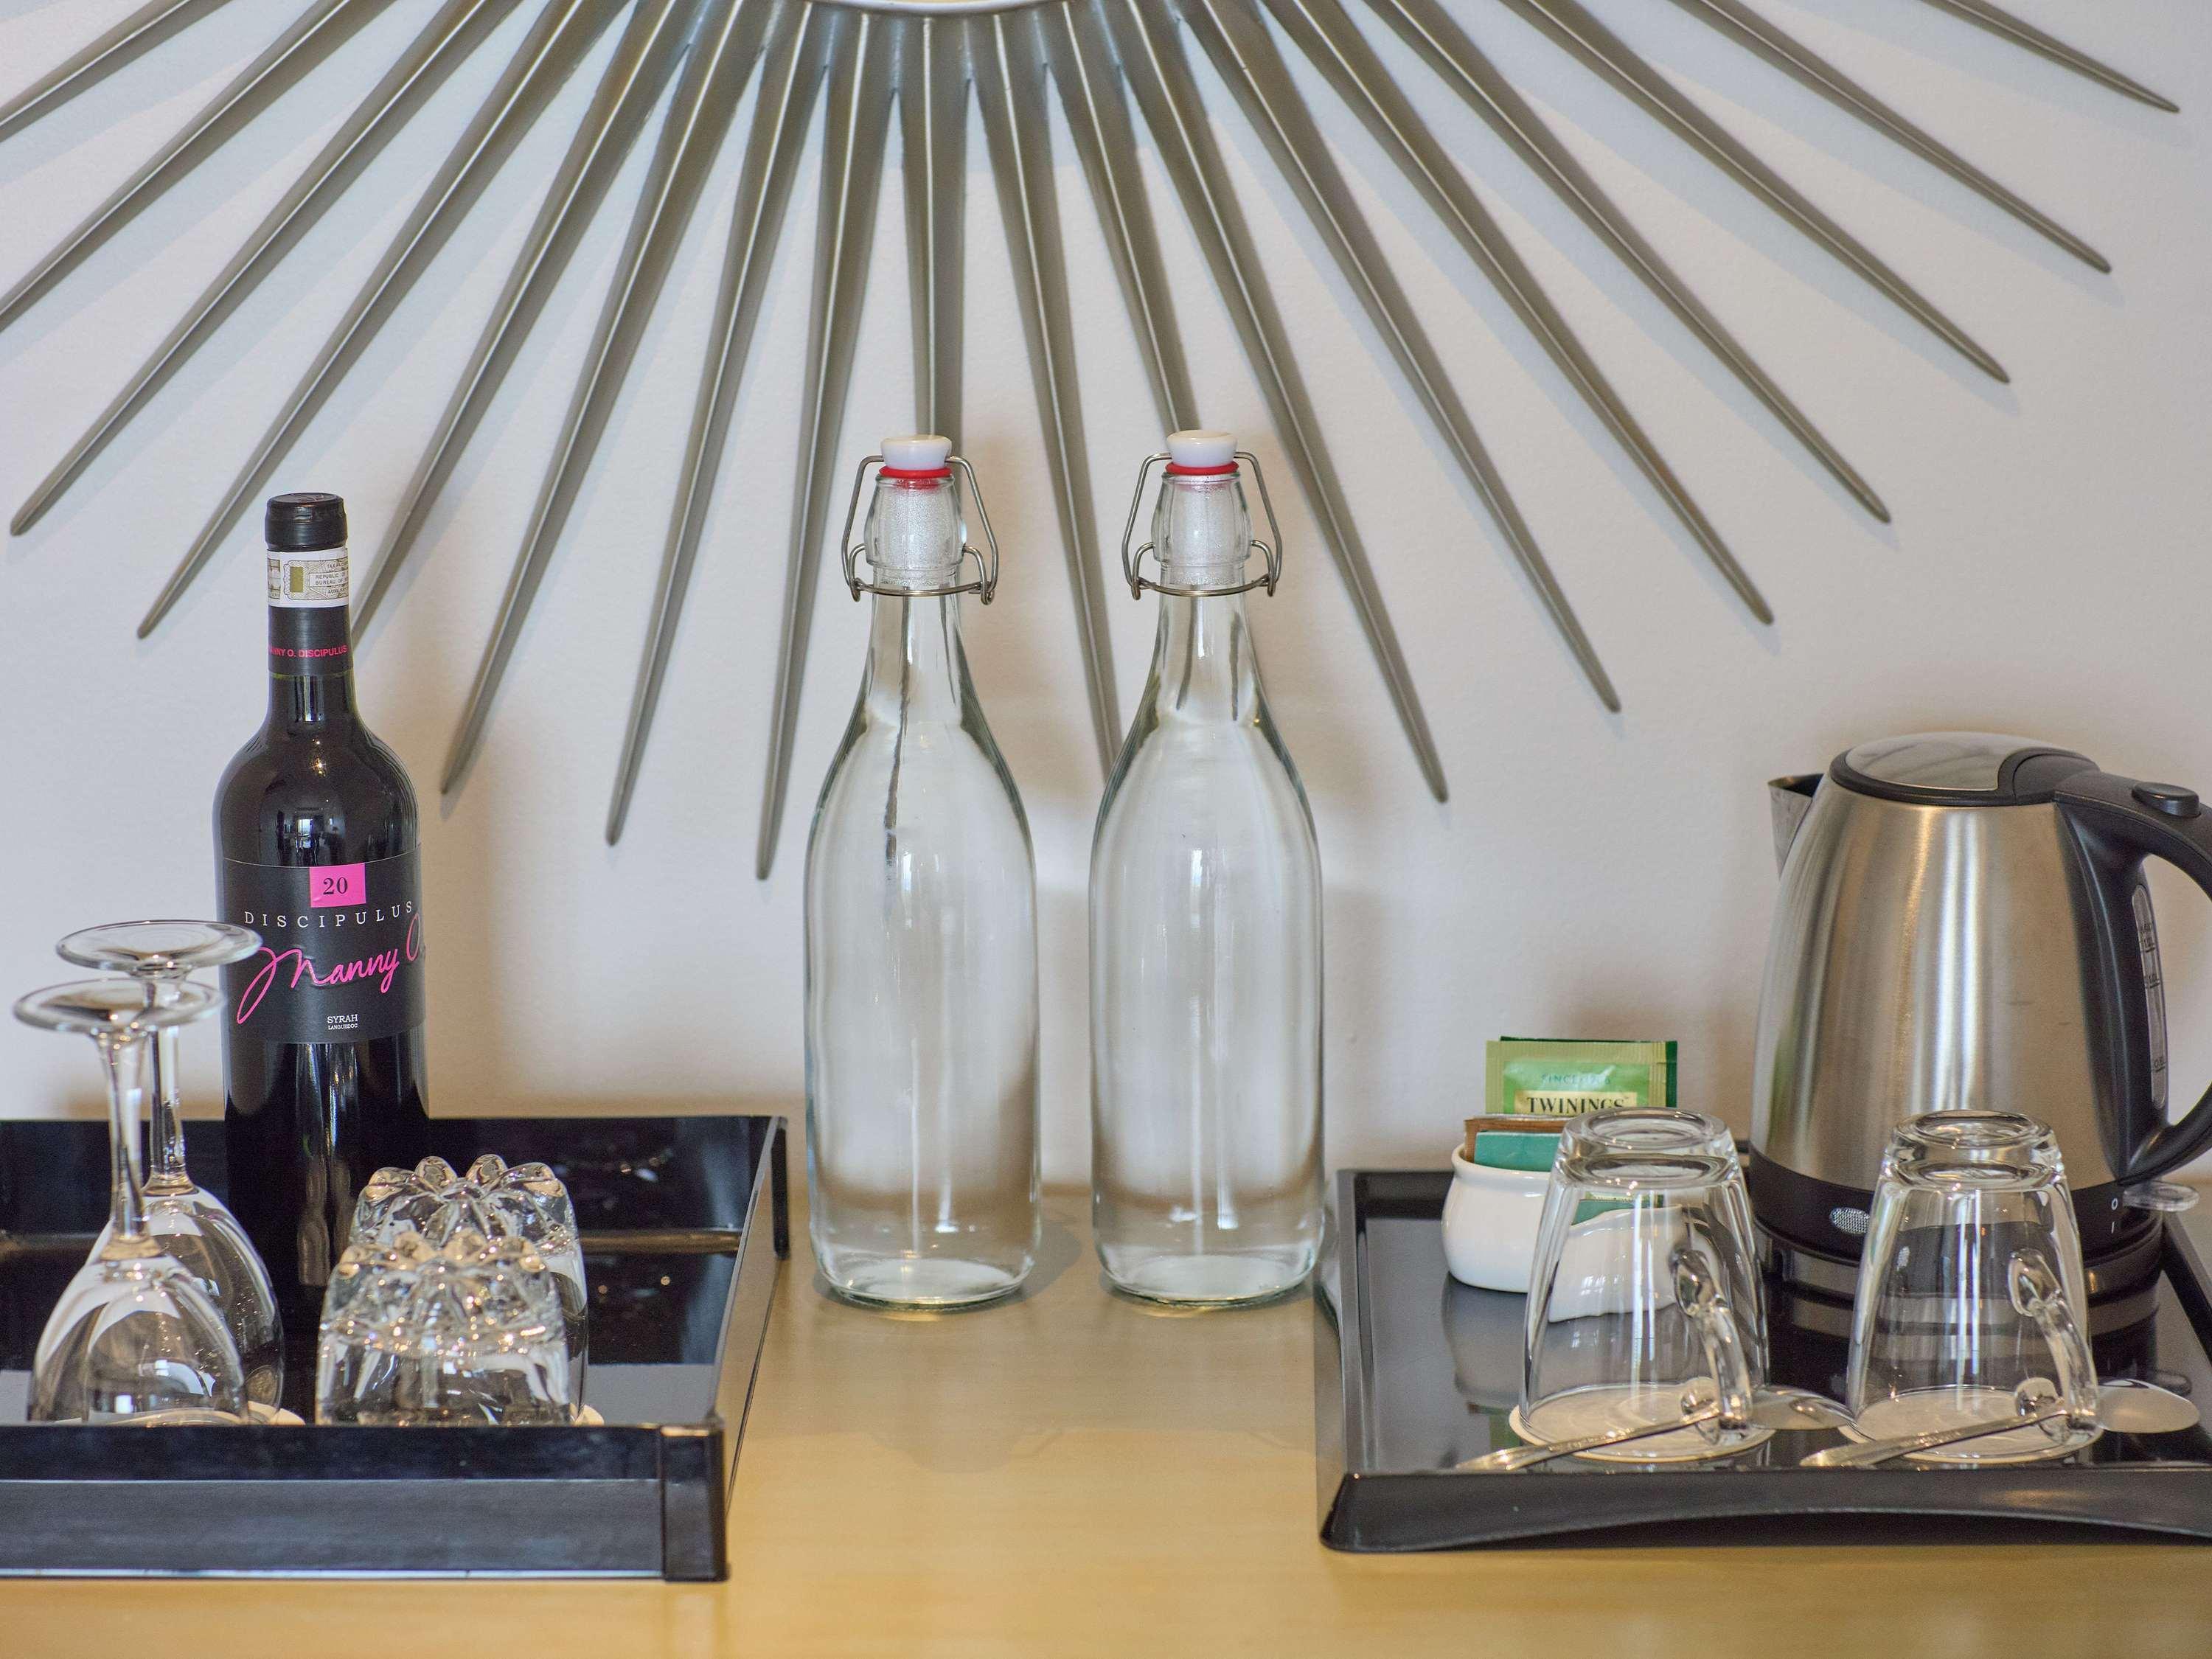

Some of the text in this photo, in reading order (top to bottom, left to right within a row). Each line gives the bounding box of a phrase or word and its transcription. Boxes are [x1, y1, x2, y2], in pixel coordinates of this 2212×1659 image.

[298, 645, 347, 657] DISCIPULUS
[323, 877, 348, 895] 20
[245, 900, 412, 928] DISCIPULUS
[237, 946, 400, 1025] Manny
[327, 1014, 358, 1024] SYRAH
